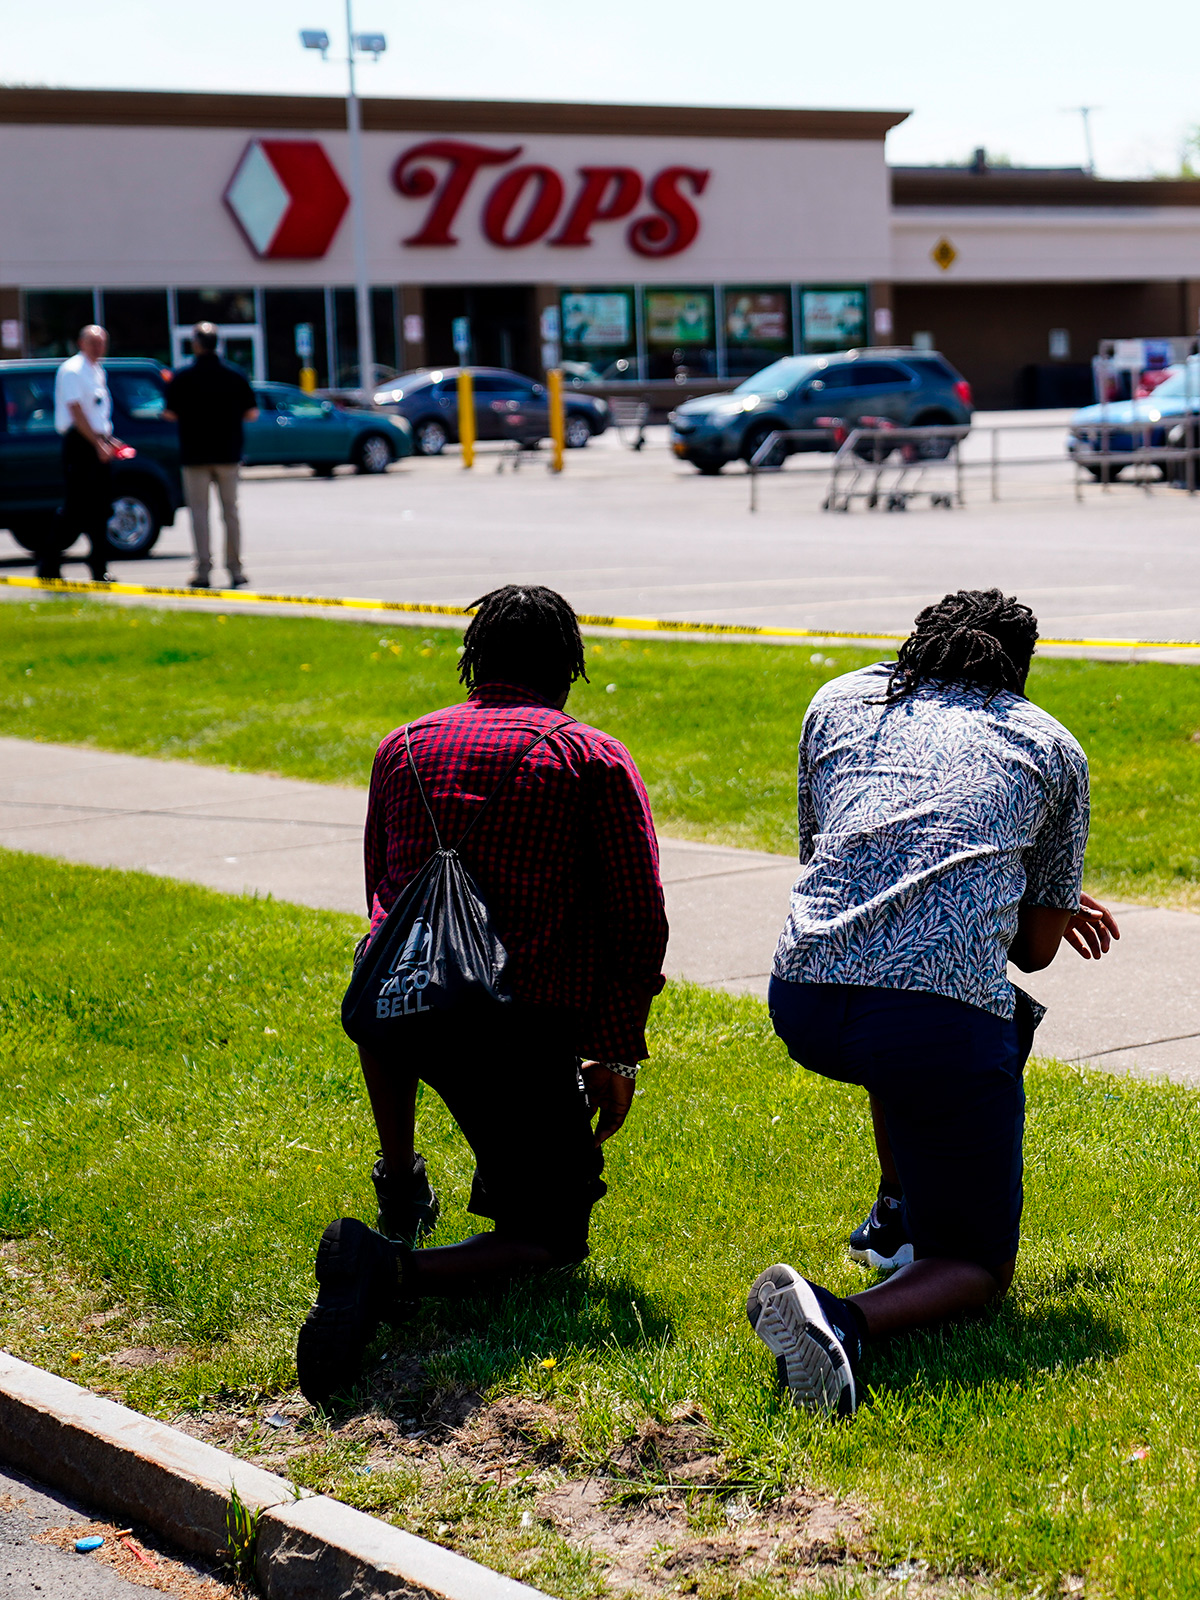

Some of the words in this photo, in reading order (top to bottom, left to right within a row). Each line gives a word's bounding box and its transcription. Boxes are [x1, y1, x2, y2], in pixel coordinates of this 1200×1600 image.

[392, 140, 710, 258] TOPS
[379, 970, 430, 995] TACO
[377, 992, 430, 1018] BELL
